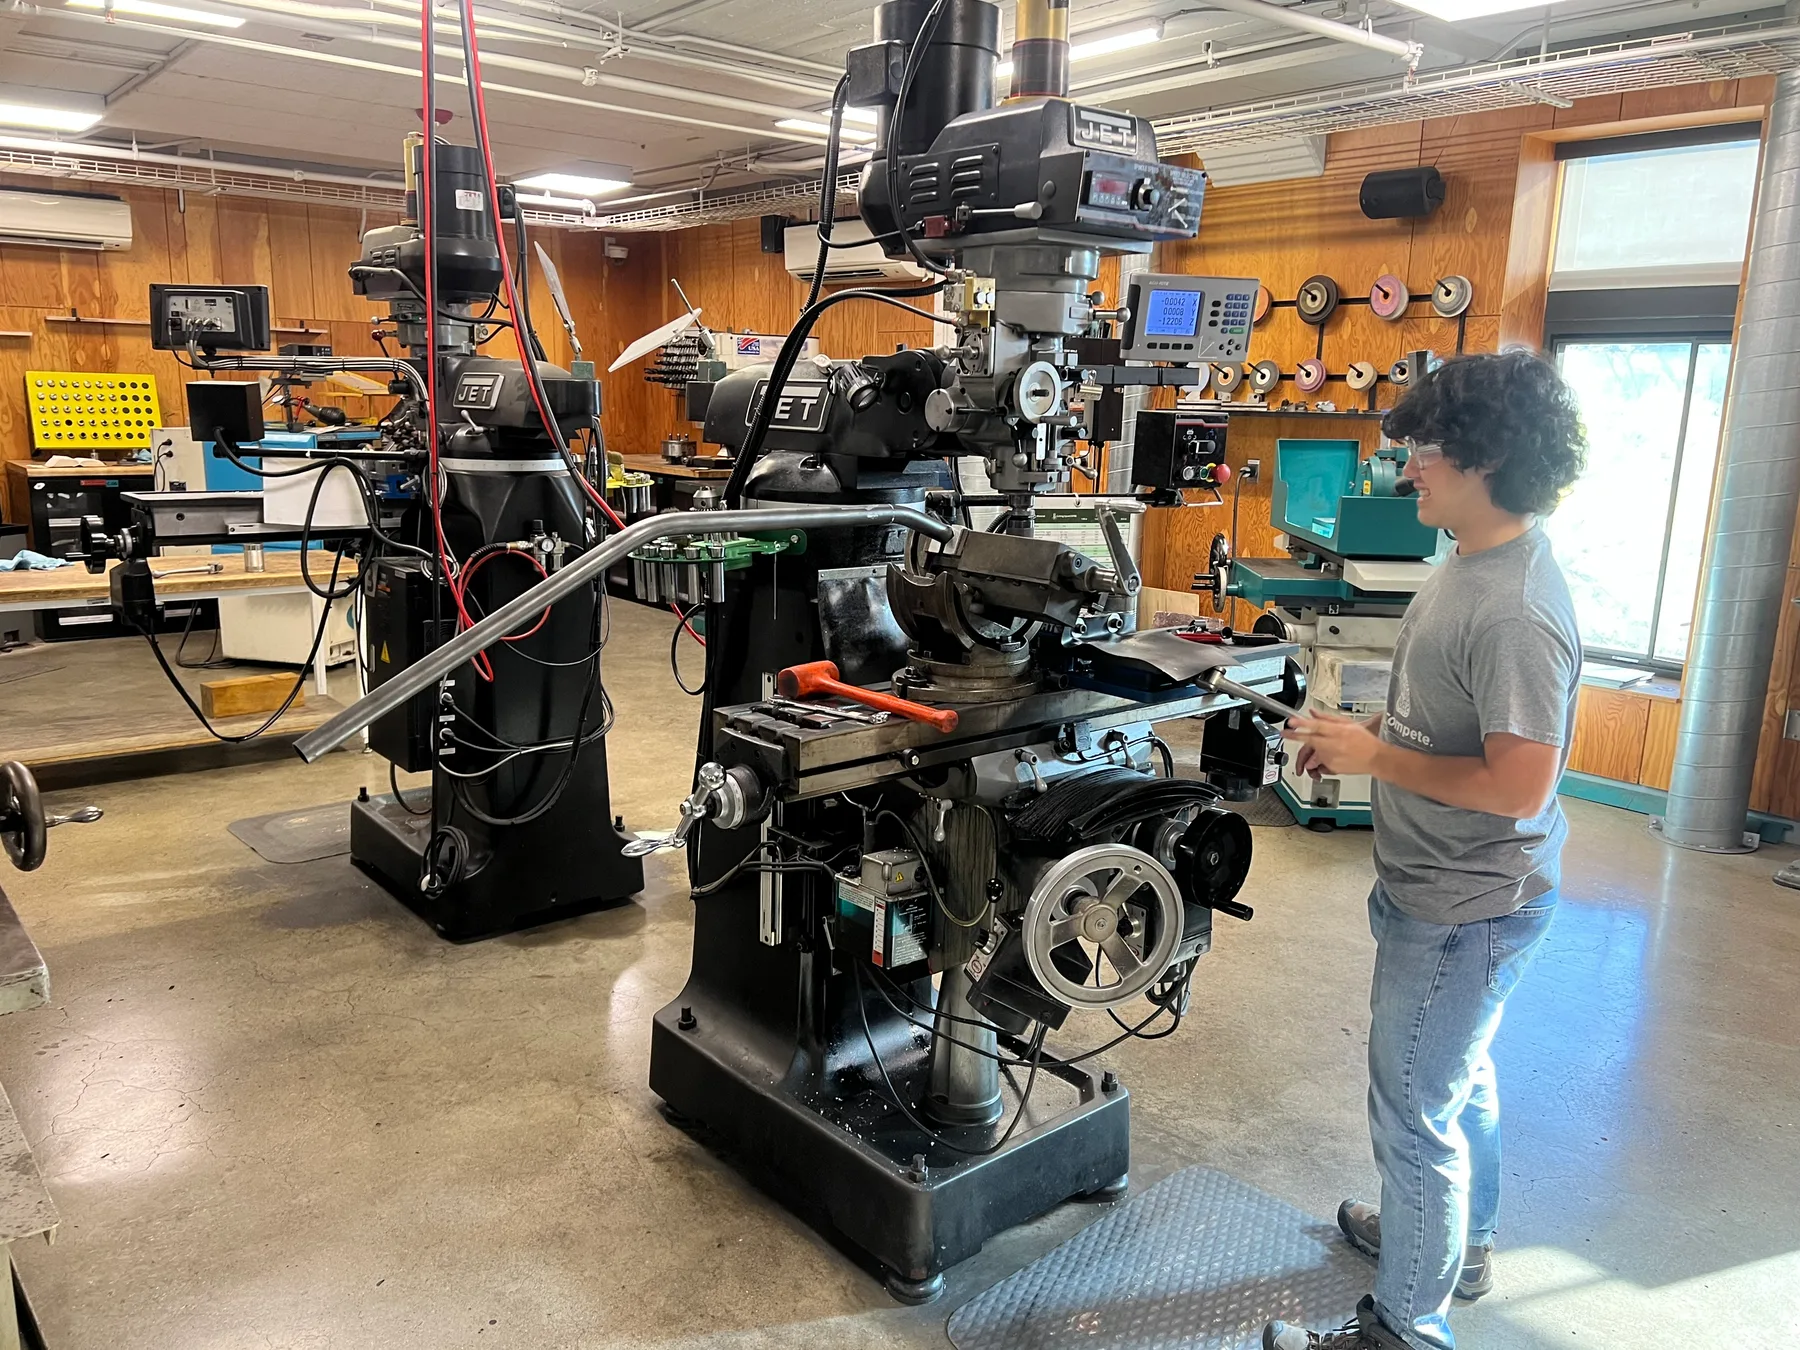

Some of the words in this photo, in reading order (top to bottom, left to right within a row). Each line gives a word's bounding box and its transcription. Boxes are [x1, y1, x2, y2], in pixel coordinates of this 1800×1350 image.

[1080, 121, 1132, 147] JET
[458, 386, 492, 402] JET
[757, 397, 819, 421] ET
